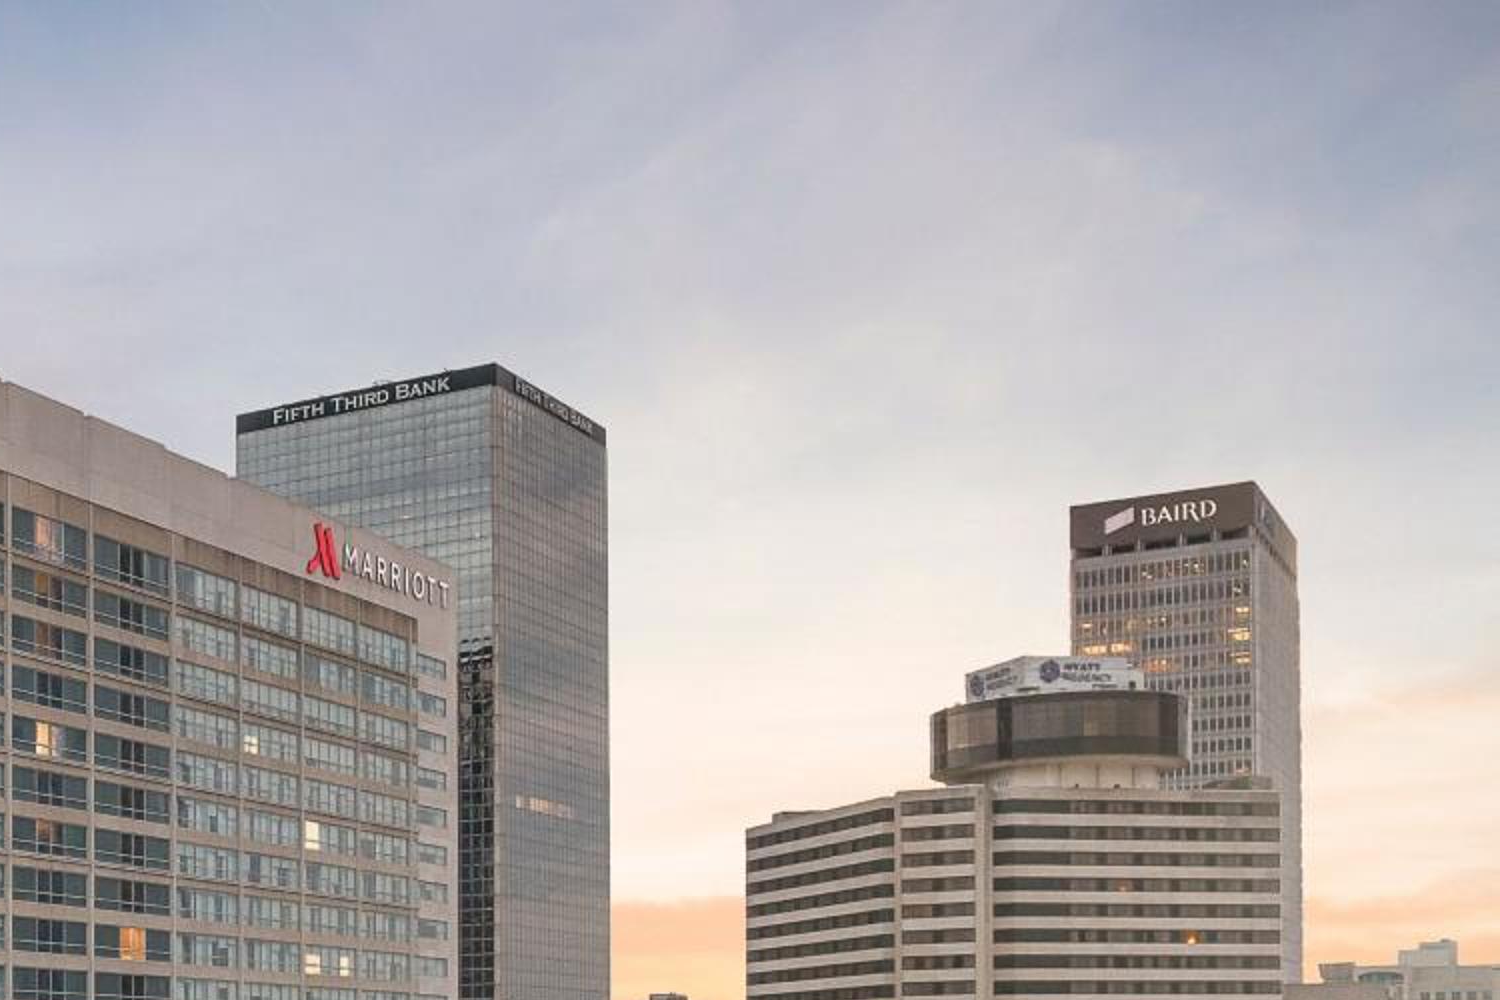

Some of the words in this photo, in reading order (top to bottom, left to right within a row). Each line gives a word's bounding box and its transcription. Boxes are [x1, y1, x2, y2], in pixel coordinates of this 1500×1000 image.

[273, 402, 325, 424] FIFTH
[331, 389, 389, 412] THIRD
[395, 377, 450, 400] BANK
[1141, 500, 1217, 526] BAIRD
[341, 543, 449, 609] MARRIOTT
